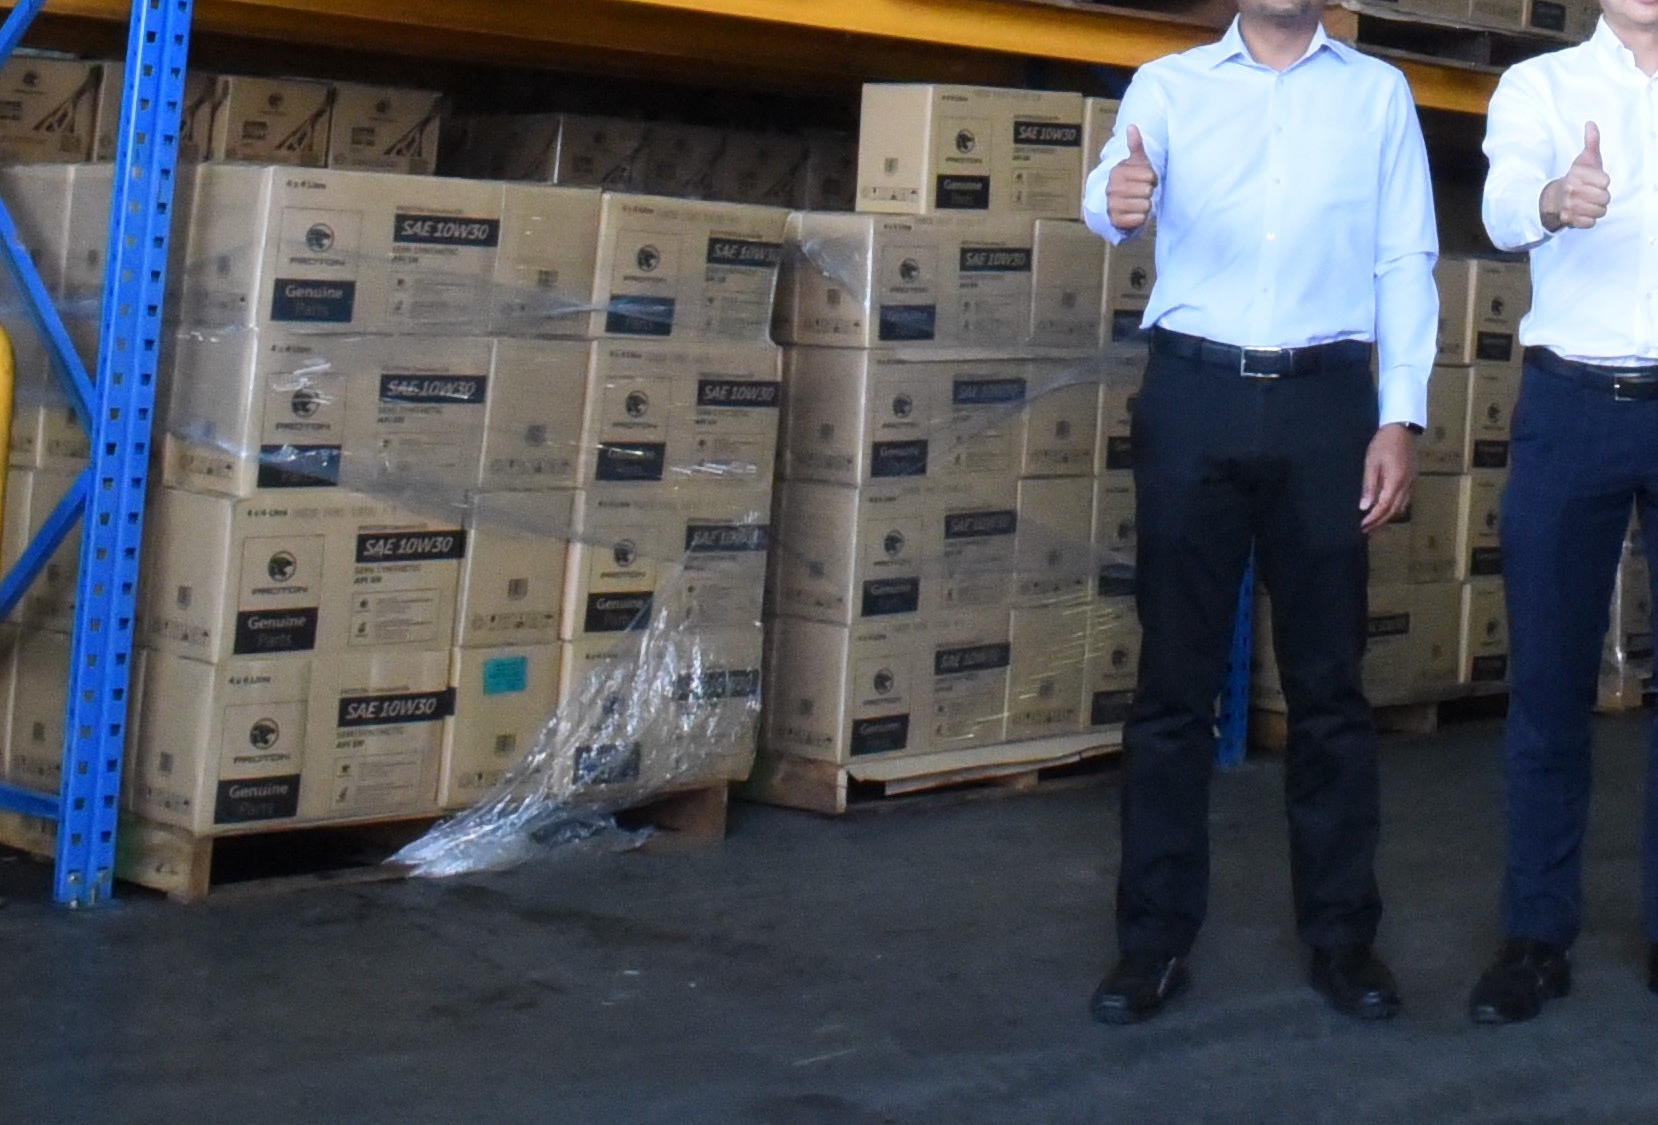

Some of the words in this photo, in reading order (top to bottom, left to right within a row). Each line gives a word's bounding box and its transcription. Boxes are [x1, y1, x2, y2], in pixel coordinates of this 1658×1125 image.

[1018, 126, 1039, 140] SAE
[1040, 127, 1077, 142] 10W30
[401, 219, 433, 236] SAE
[433, 222, 490, 240] 10W30
[290, 256, 346, 267] PROTON
[966, 252, 988, 266] SAE
[285, 284, 344, 300] Genuine
[386, 379, 418, 396] SAE
[419, 380, 476, 398] 10W30
[703, 385, 728, 400] SAE
[731, 386, 776, 401] 10W30
[363, 538, 395, 556] SAE
[395, 536, 454, 554] 10W30
[252, 585, 308, 596] PROTON
[247, 615, 306, 630] Genuine
[345, 702, 380, 719] SAE
[380, 697, 437, 718] 10W30
[233, 753, 290, 764] PROTON
[229, 784, 289, 799] Genuine
